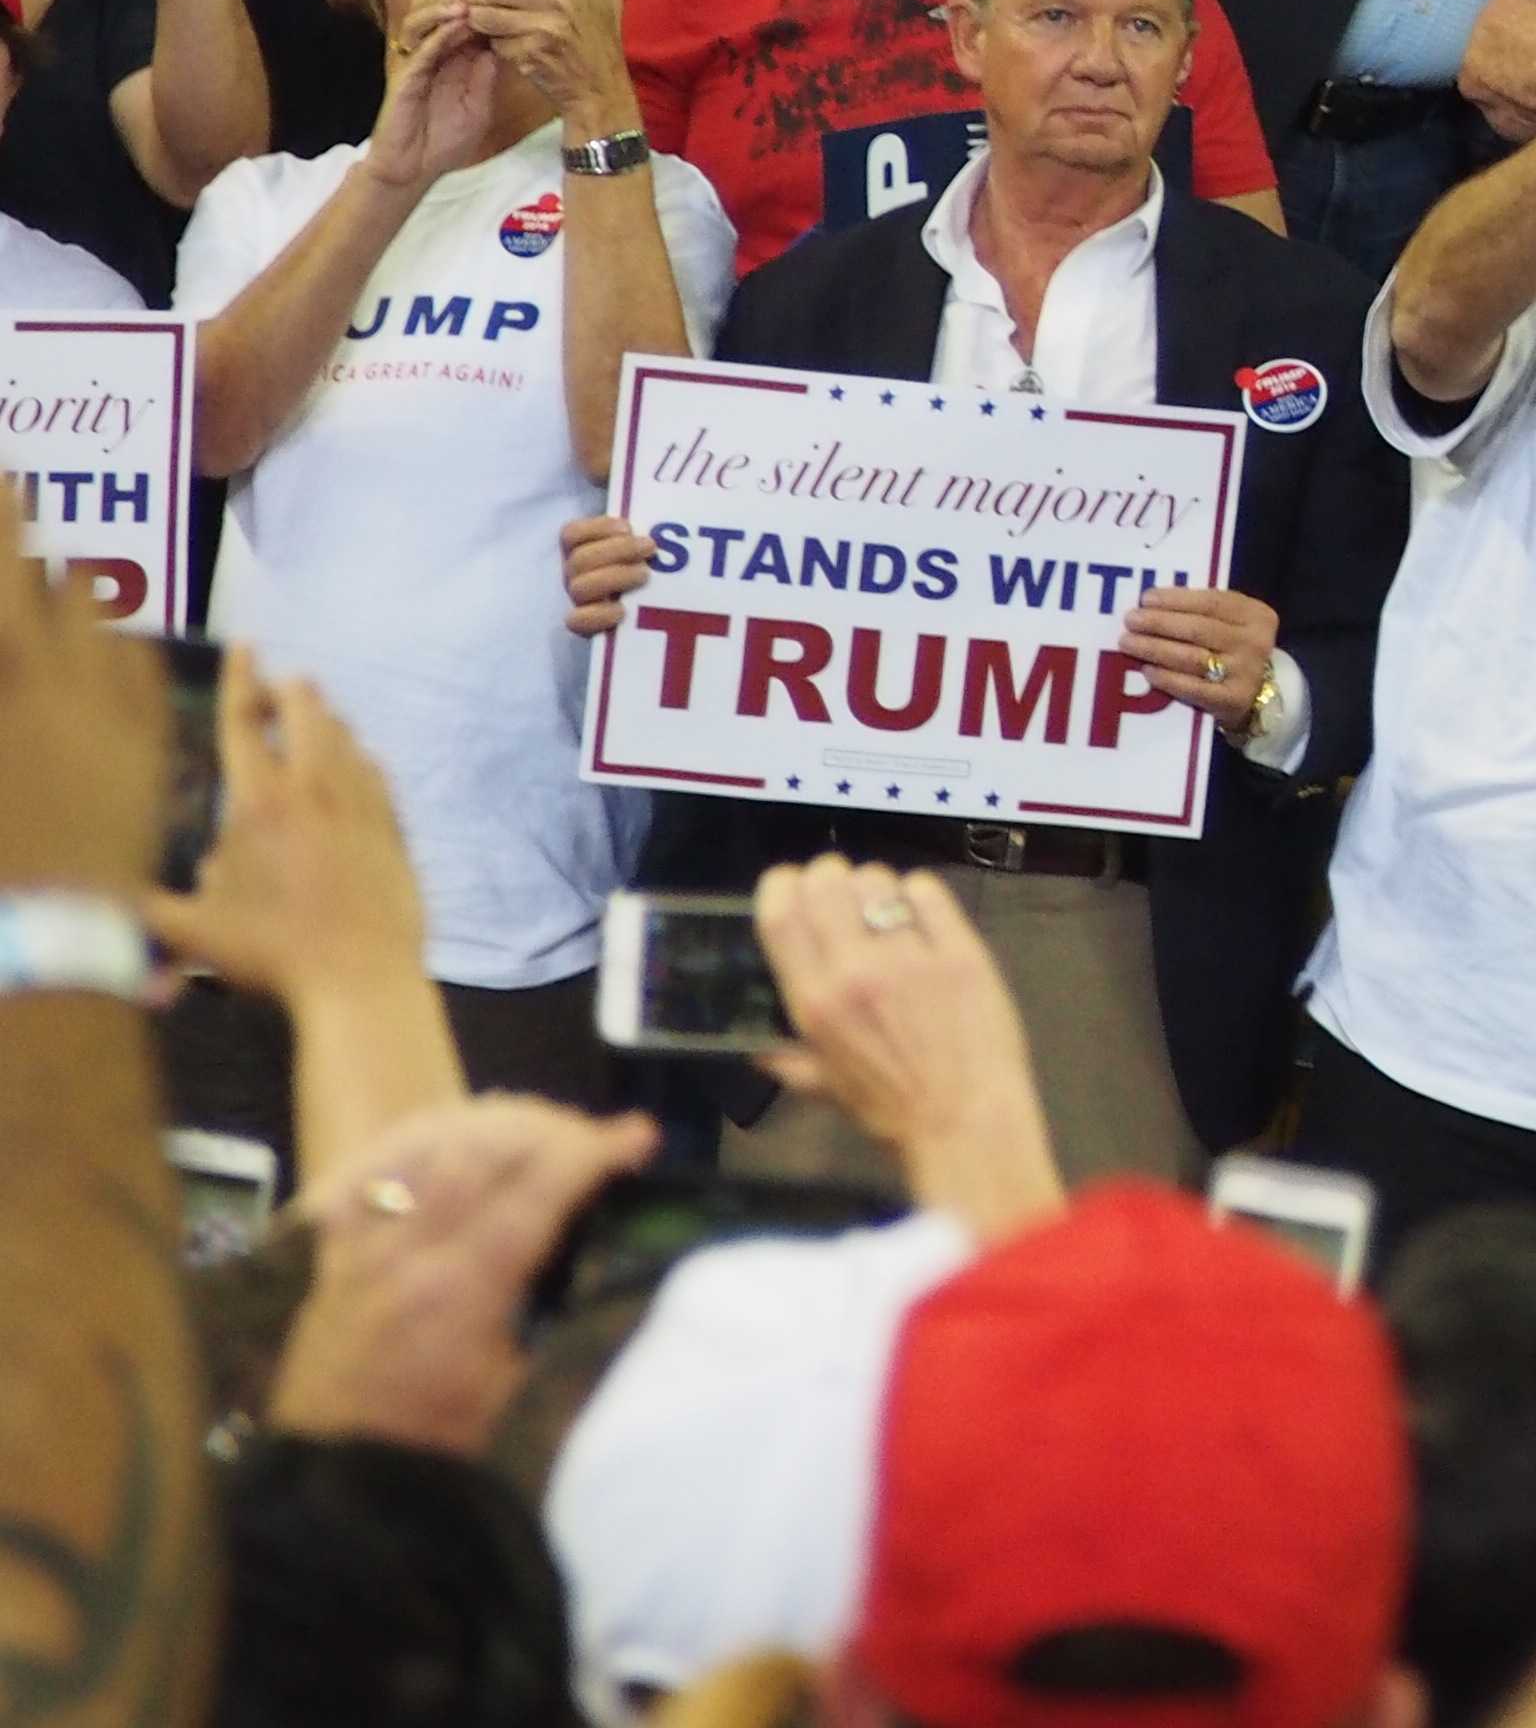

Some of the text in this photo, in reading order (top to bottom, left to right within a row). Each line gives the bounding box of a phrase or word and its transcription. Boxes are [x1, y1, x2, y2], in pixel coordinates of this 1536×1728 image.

[346, 295, 541, 341] UMP
[365, 361, 431, 381] GREAT
[440, 363, 524, 391] AGAIN!
[1256, 368, 1306, 391] TRUMP
[0, 379, 155, 454] ority
[5, 471, 149, 523] ITH
[651, 427, 1202, 549] the silent majority
[648, 521, 959, 602] STANDS
[636, 605, 1176, 750] TRUMP
